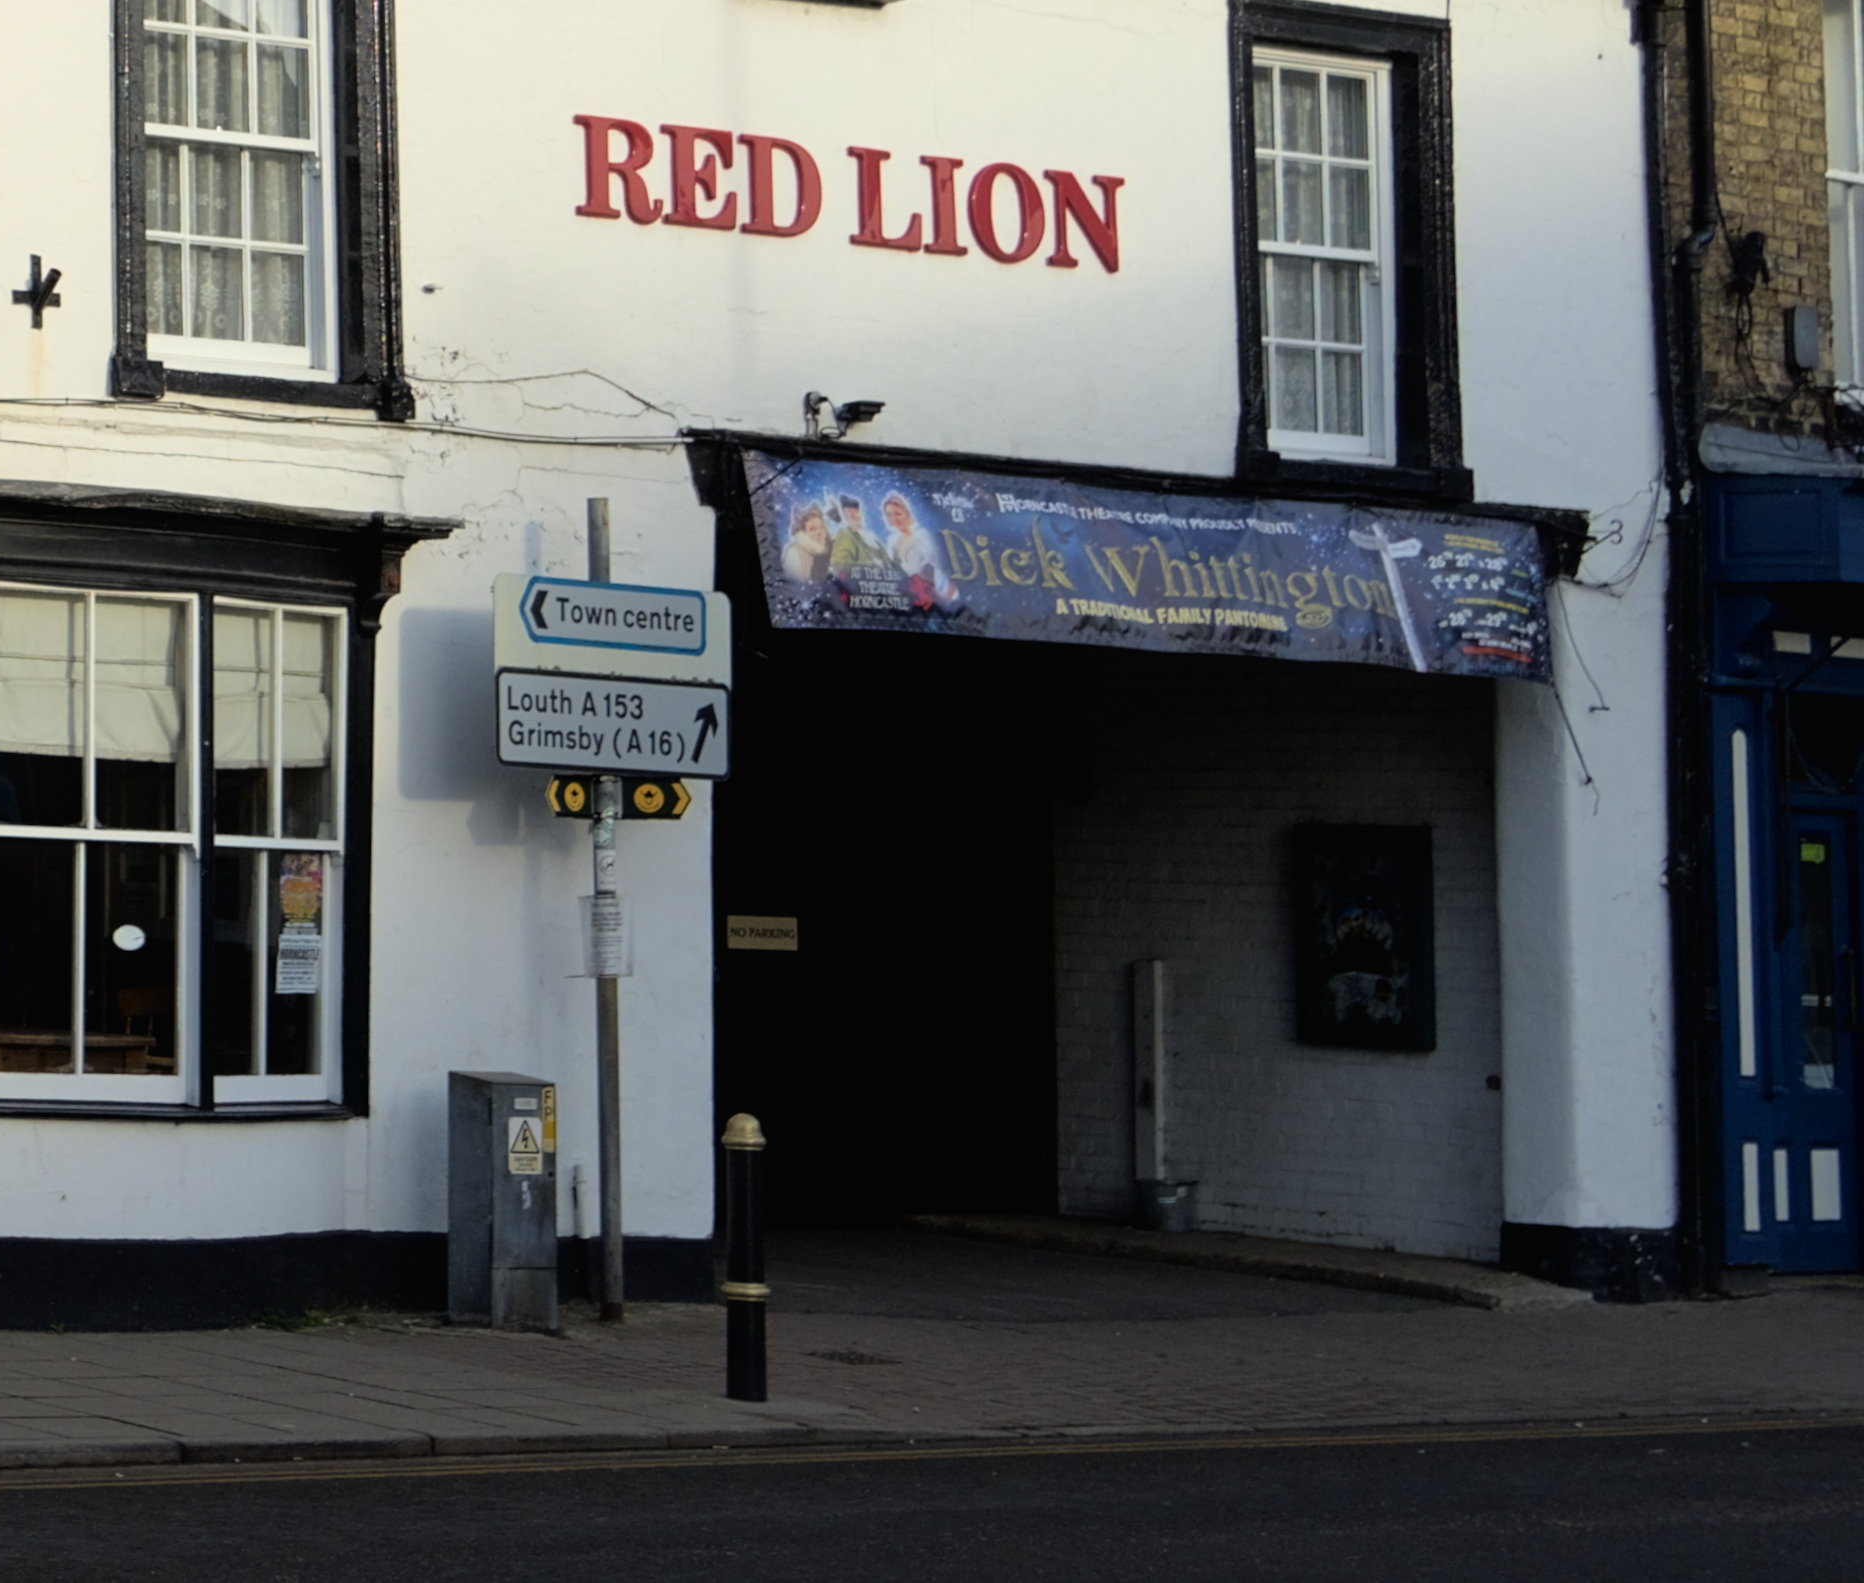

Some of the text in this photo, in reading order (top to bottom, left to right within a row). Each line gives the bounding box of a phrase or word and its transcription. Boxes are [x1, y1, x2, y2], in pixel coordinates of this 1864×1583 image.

[572, 113, 1126, 275] RED LION
[942, 514, 1398, 629] Dick Whittington
[555, 597, 695, 633] Town centre
[849, 595, 910, 611] HORNCASTLE
[1055, 598, 1069, 615] A
[1069, 598, 1154, 624] TRADITIONAL
[1156, 607, 1211, 626] FAMILY
[507, 685, 572, 715] Louth
[508, 720, 604, 756] Grimsby
[730, 927, 795, 940] NO PARKING
